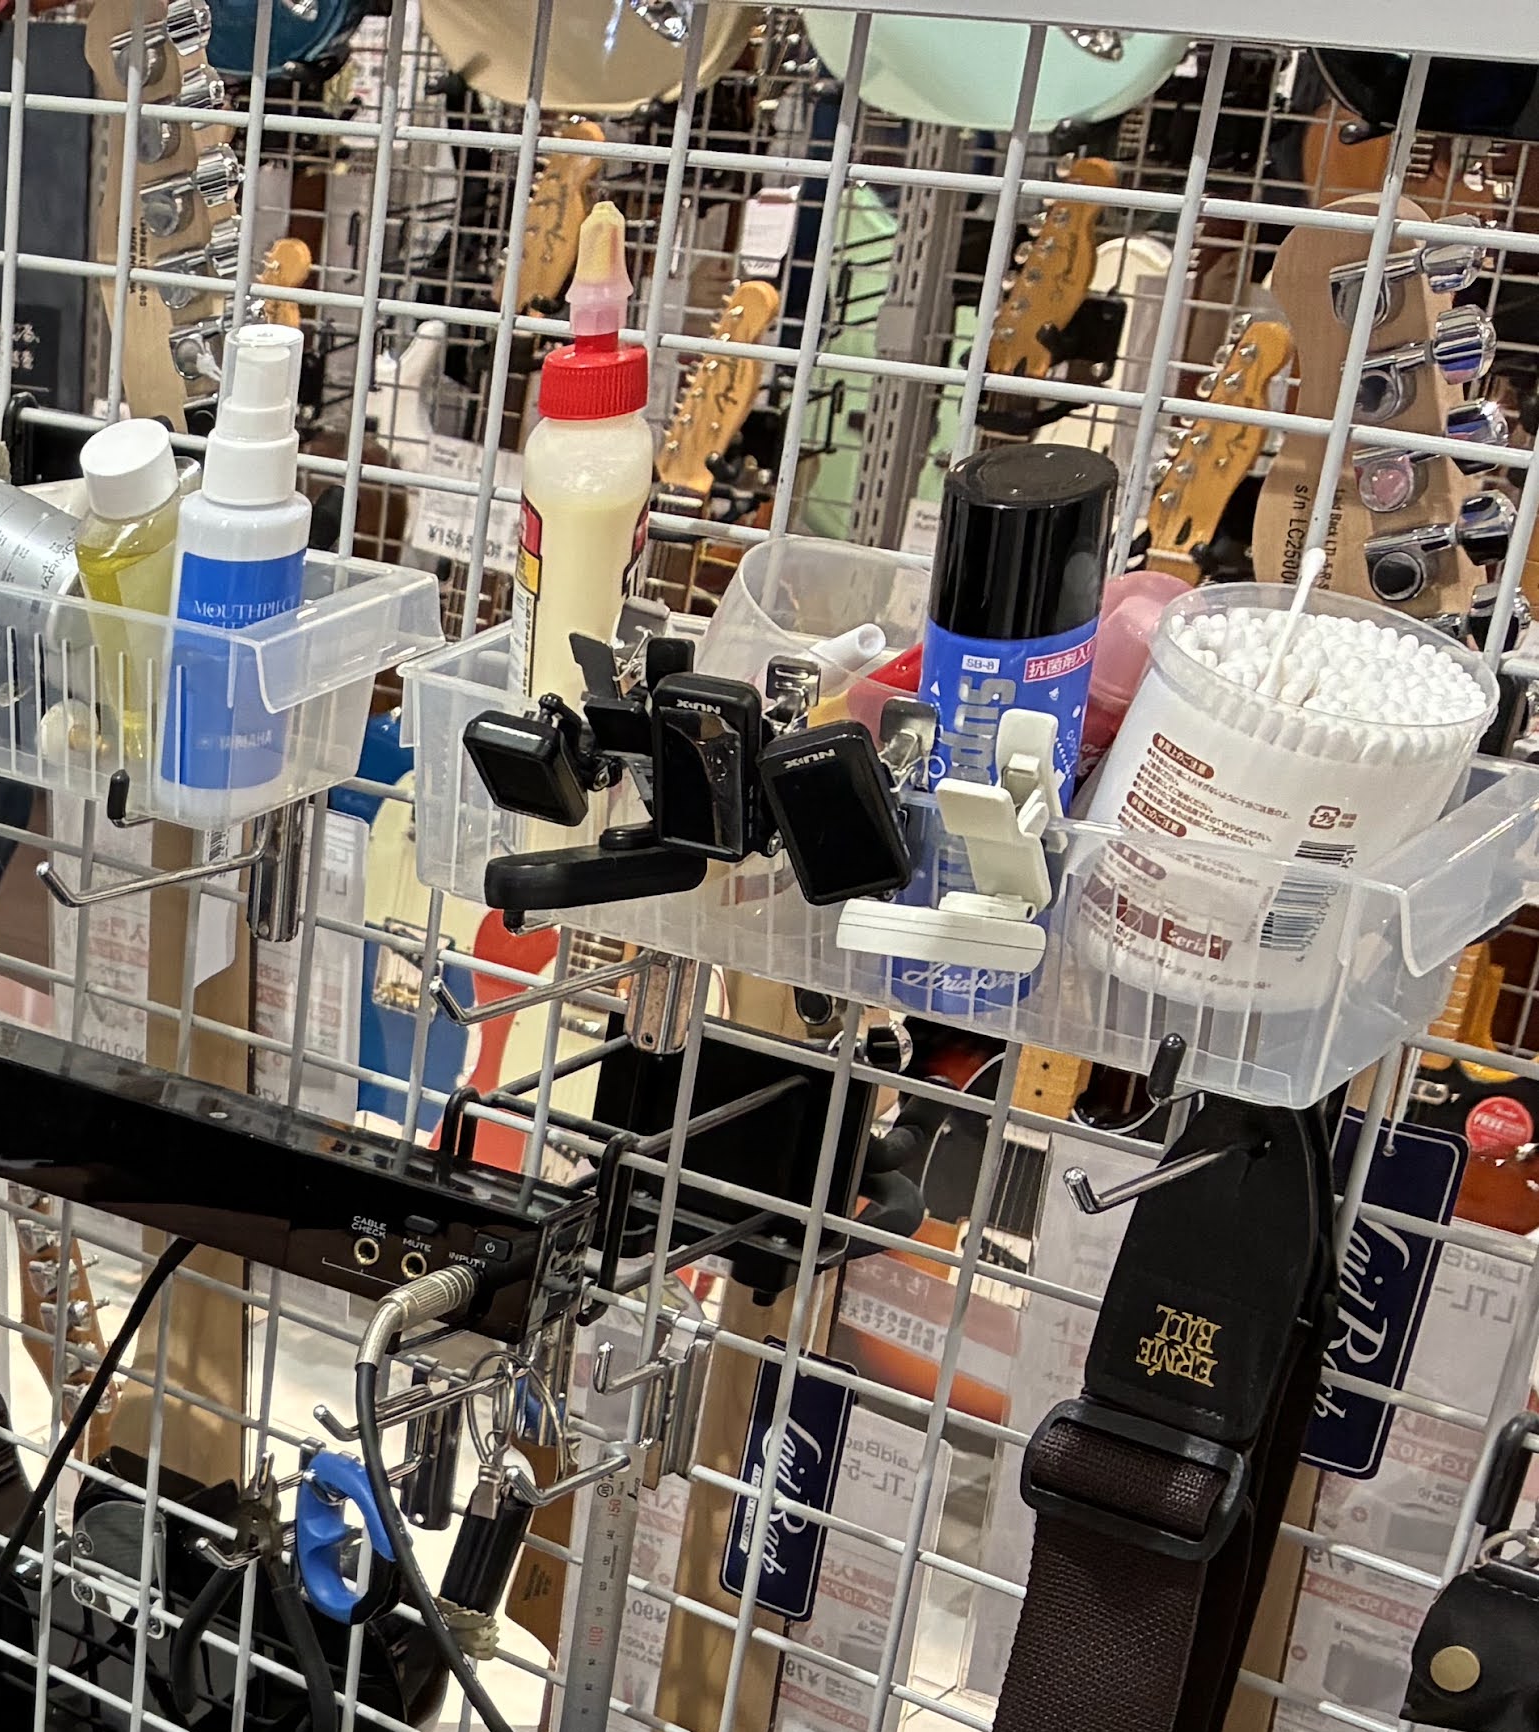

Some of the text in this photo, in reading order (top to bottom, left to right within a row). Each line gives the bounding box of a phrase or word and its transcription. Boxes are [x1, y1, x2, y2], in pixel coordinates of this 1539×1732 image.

[965, 655, 996, 671] SB-8
[351, 1223, 387, 1239] CHECK
[352, 1215, 387, 1231] CABLE
[402, 1237, 432, 1252] MUTE
[1154, 1303, 1222, 1354] BALL
[1135, 1336, 1219, 1388] ERNIE
